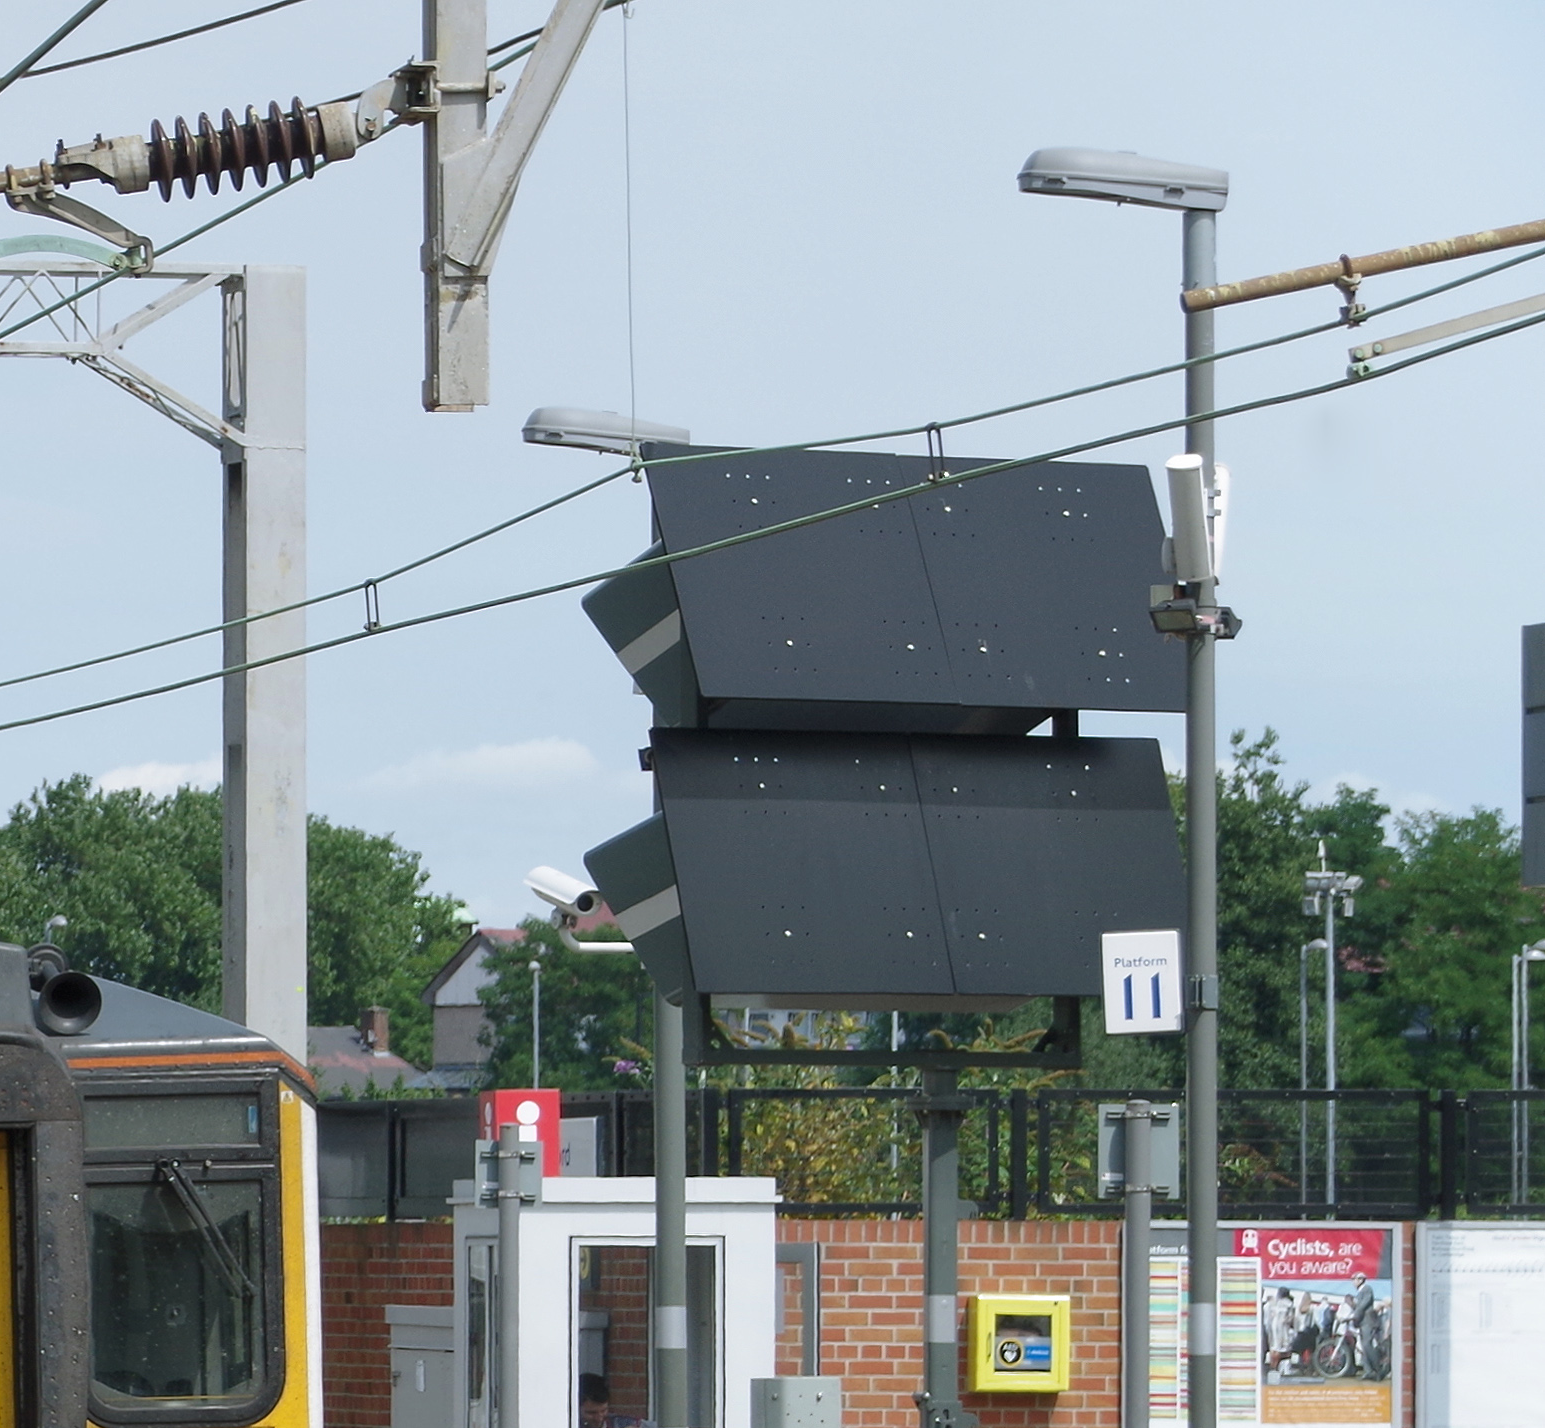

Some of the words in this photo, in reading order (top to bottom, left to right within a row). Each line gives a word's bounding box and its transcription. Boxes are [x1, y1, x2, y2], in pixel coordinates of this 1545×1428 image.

[1113, 956, 1168, 968] Platform
[1123, 972, 1161, 1020] 11
[1267, 1239, 1335, 1257] Cyclists,
[1339, 1242, 1363, 1255] are
[1268, 1260, 1297, 1276] you
[1300, 1259, 1354, 1275] aware?
